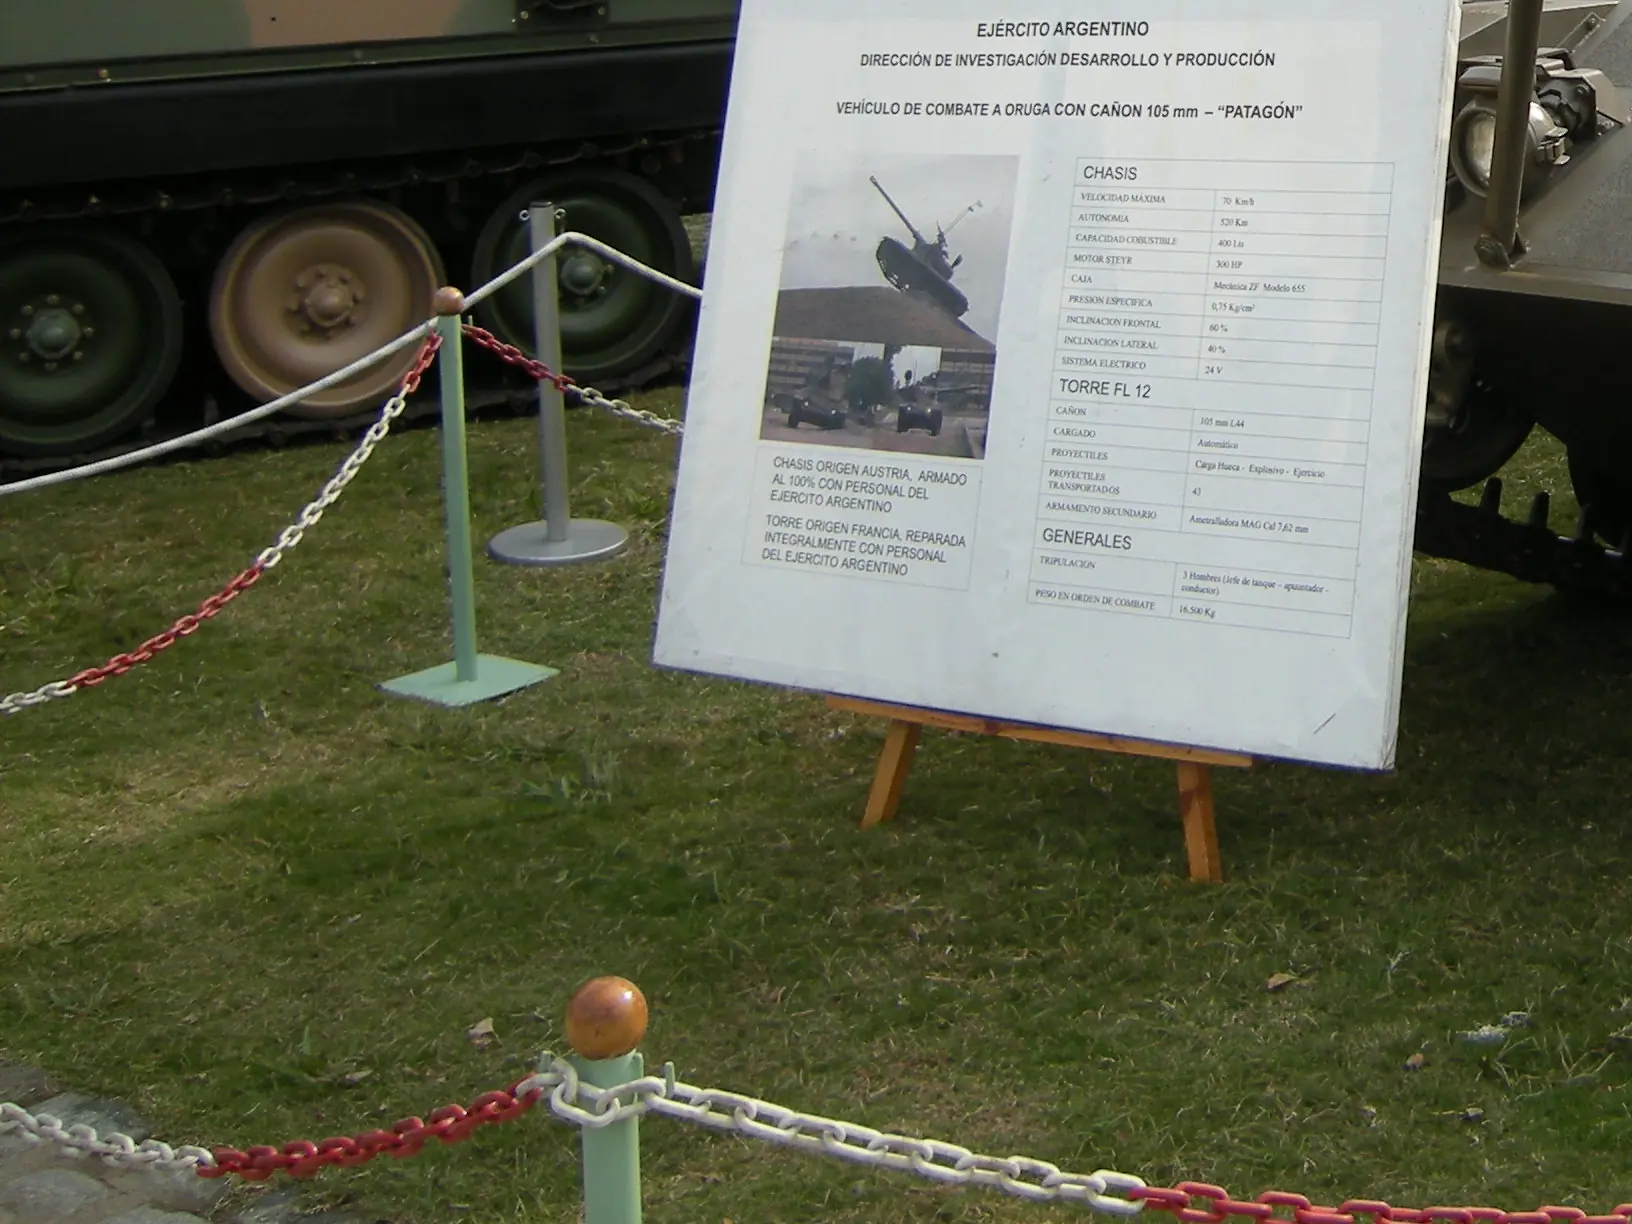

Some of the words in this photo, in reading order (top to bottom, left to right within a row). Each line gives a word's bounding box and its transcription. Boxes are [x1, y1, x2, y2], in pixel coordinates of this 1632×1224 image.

[977, 18, 1050, 38] EJÉRCITO
[1053, 21, 1149, 37] ARGENTINO
[860, 50, 931, 67] DIRECCIÓN
[936, 53, 952, 67] DE
[955, 50, 1056, 67] INVESTIGACIÓN
[1060, 52, 1159, 67] DESARROLLO
[1163, 53, 1173, 66] Y
[1176, 50, 1276, 67] PRODUCCIÓN
[836, 99, 900, 116] VEHÍCULO
[903, 102, 922, 116] DE
[925, 102, 990, 117] COMBATE
[992, 103, 1002, 116] A
[1004, 102, 1053, 118] ORUGA
[1055, 102, 1087, 118] CON
[1090, 99, 1143, 118] CAÑON
[1147, 104, 1170, 118] 105
[1173, 108, 1199, 119] mm
[1084, 165, 1138, 181] CHASIS
[1081, 192, 1129, 202] VELOCIDAD
[1130, 192, 1166, 204] MÁXIMA
[1220, 218, 1234, 227] 520
[1235, 219, 1248, 227] Km
[1076, 233, 1125, 244] CAPACIDAD
[1126, 236, 1178, 246] COBUSTIBLE
[1218, 239, 1232, 248] 400
[1073, 254, 1104, 264] MOTOR
[1105, 255, 1133, 265] STEYR
[1216, 260, 1230, 268] 300
[1231, 261, 1243, 269] HP
[1071, 274, 1092, 284] CAJA
[1249, 283, 1260, 292] ZF
[1263, 283, 1291, 292] Modelo
[1292, 284, 1306, 293] 655
[1068, 294, 1104, 304] PRESION
[1105, 296, 1153, 308] ESPECIFICA
[1066, 314, 1122, 327] INCLINACION
[1122, 318, 1162, 329] FRONTAL
[1064, 335, 1120, 348] INCLINACION
[1120, 339, 1159, 350] LATERAL
[1062, 356, 1098, 367] SISTEMA
[1099, 359, 1146, 370] ELECTRICO
[1204, 366, 1215, 374] 24
[1216, 366, 1224, 375] V
[1060, 378, 1110, 396] TORRE
[1114, 382, 1131, 398] FL
[1136, 383, 1152, 398] 12
[1056, 405, 1087, 416] CAÑON
[1053, 427, 1096, 438] CARGADO
[1051, 448, 1108, 461] PROYECTILES
[773, 456, 813, 472] CHASIS
[816, 460, 860, 476] ORIGEN
[917, 470, 968, 486] ARMADO
[1048, 468, 1106, 482] PROYECTILES
[772, 473, 786, 486] AL
[789, 475, 816, 490] 100%
[818, 478, 844, 492] CON
[845, 481, 906, 498] PERSONAL
[908, 486, 930, 500] DEL
[1048, 480, 1120, 495] TRANSPORTADOS
[1192, 487, 1202, 496] 43
[770, 489, 824, 507] EJERCITO
[826, 496, 892, 514] ARGENTINO
[1045, 501, 1101, 515] ARMAMENTO
[1102, 506, 1157, 520] SECUNDARIO
[766, 514, 802, 530] TORRE
[805, 518, 849, 534] ORIGEN
[905, 529, 966, 548] REPARADA
[1042, 527, 1132, 551] GENERALES
[764, 531, 857, 553] INTEGRALMENTE
[858, 542, 884, 556] CON
[886, 545, 948, 564] PERSONAL
[762, 548, 783, 562] DEL
[785, 550, 839, 568] EJERCITO
[841, 558, 909, 576] ARGENTINO
[1040, 555, 1096, 569] TRIPULACION
[1036, 588, 1056, 600] PESO
[1058, 592, 1070, 600] EN
[1071, 592, 1101, 604] ORDEN
[1102, 596, 1113, 606] DE
[1114, 598, 1156, 611] COMBATE
[1204, 608, 1216, 619] Kg
